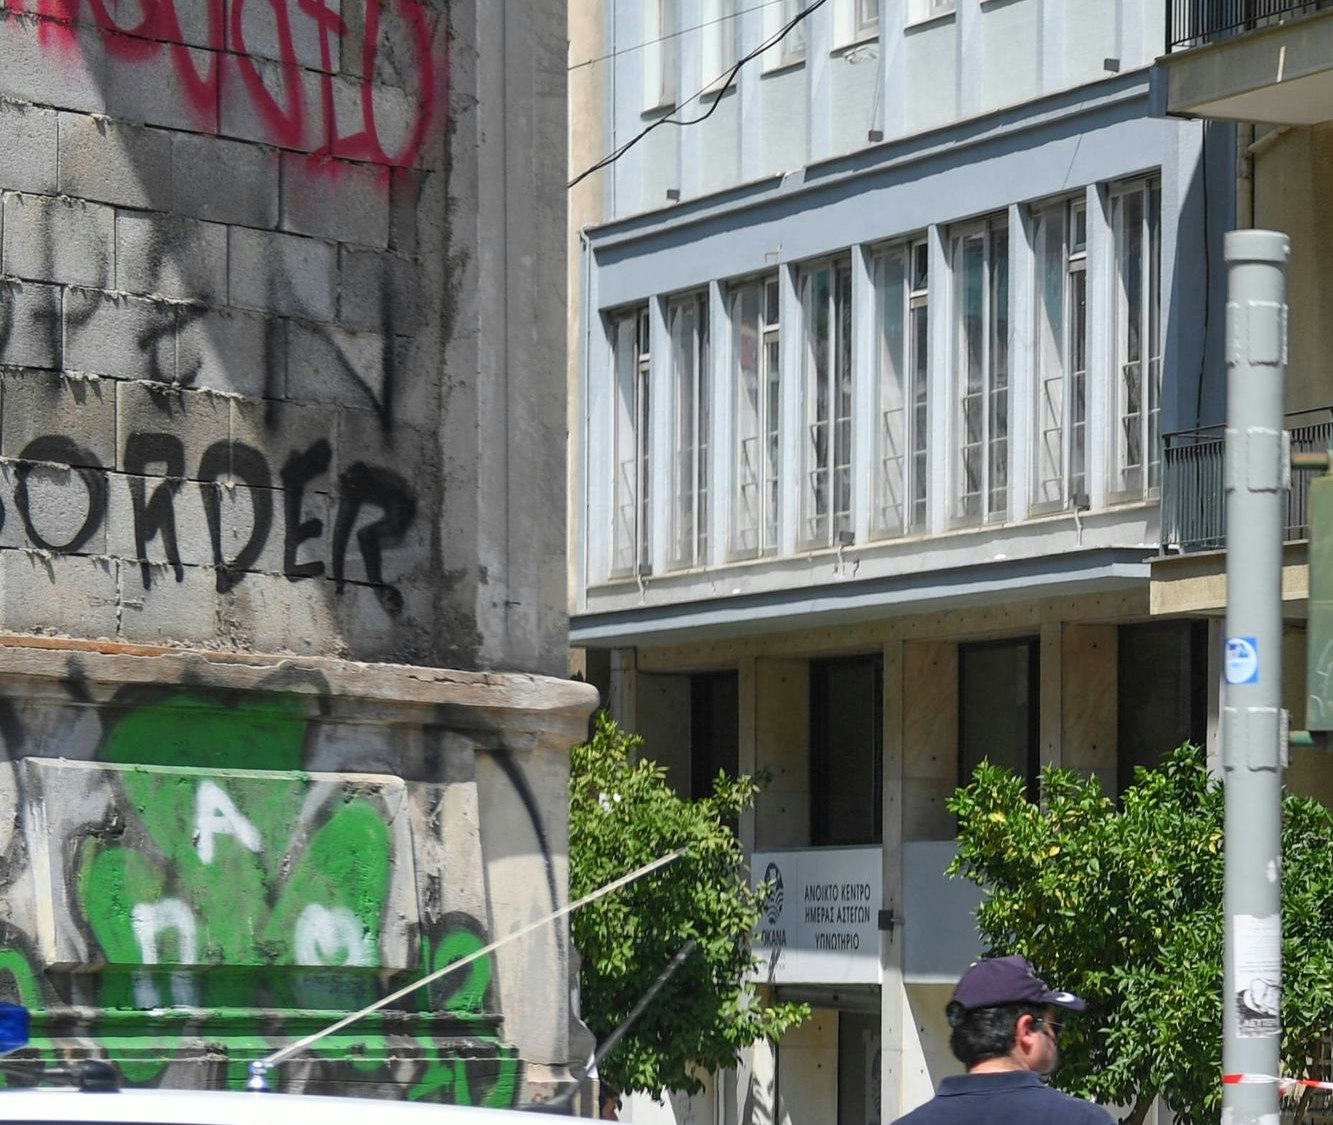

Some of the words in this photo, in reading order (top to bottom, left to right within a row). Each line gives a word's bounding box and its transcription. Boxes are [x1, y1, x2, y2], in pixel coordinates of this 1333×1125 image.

[0, 432, 418, 617] ORDER
[804, 883, 839, 902] ΑΝΟΙΚΤΟ
[841, 883, 871, 901] ΚΕΝΤΡΟ
[805, 906, 834, 924] ΗΜΕΡΑΣ
[837, 905, 870, 923] ΑΣΤΕΓΩΝ
[815, 932, 860, 950] ΥΠΝΩΤΗΡΙΟ
